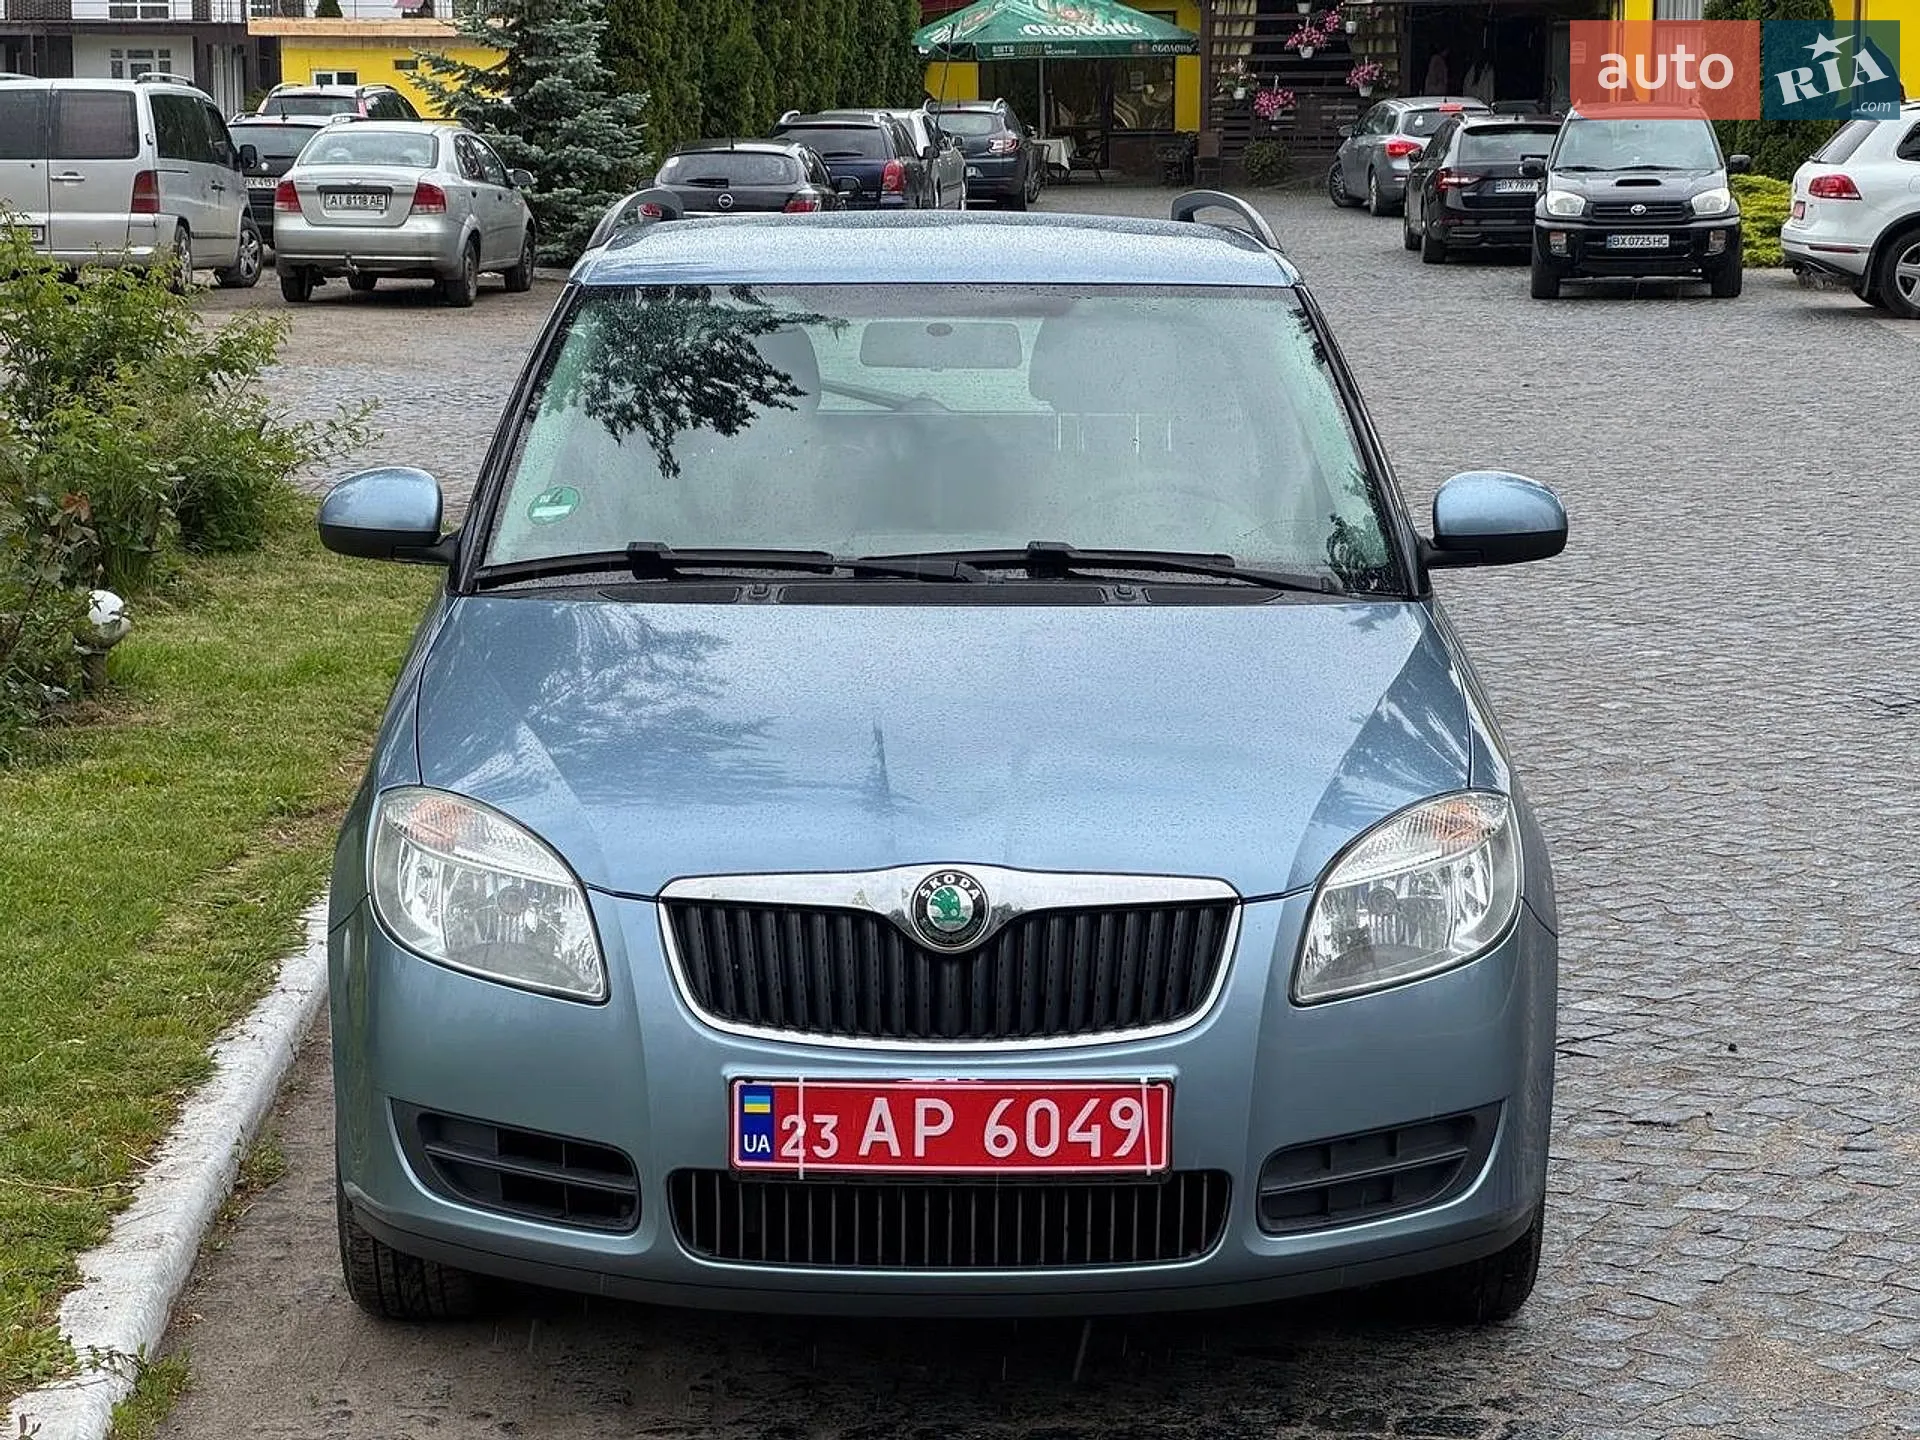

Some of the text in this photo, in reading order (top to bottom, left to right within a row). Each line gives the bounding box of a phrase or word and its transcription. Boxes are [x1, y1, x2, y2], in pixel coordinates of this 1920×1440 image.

[744, 1134, 771, 1153] UA
[779, 1097, 1144, 1158] 23 AP 6049
